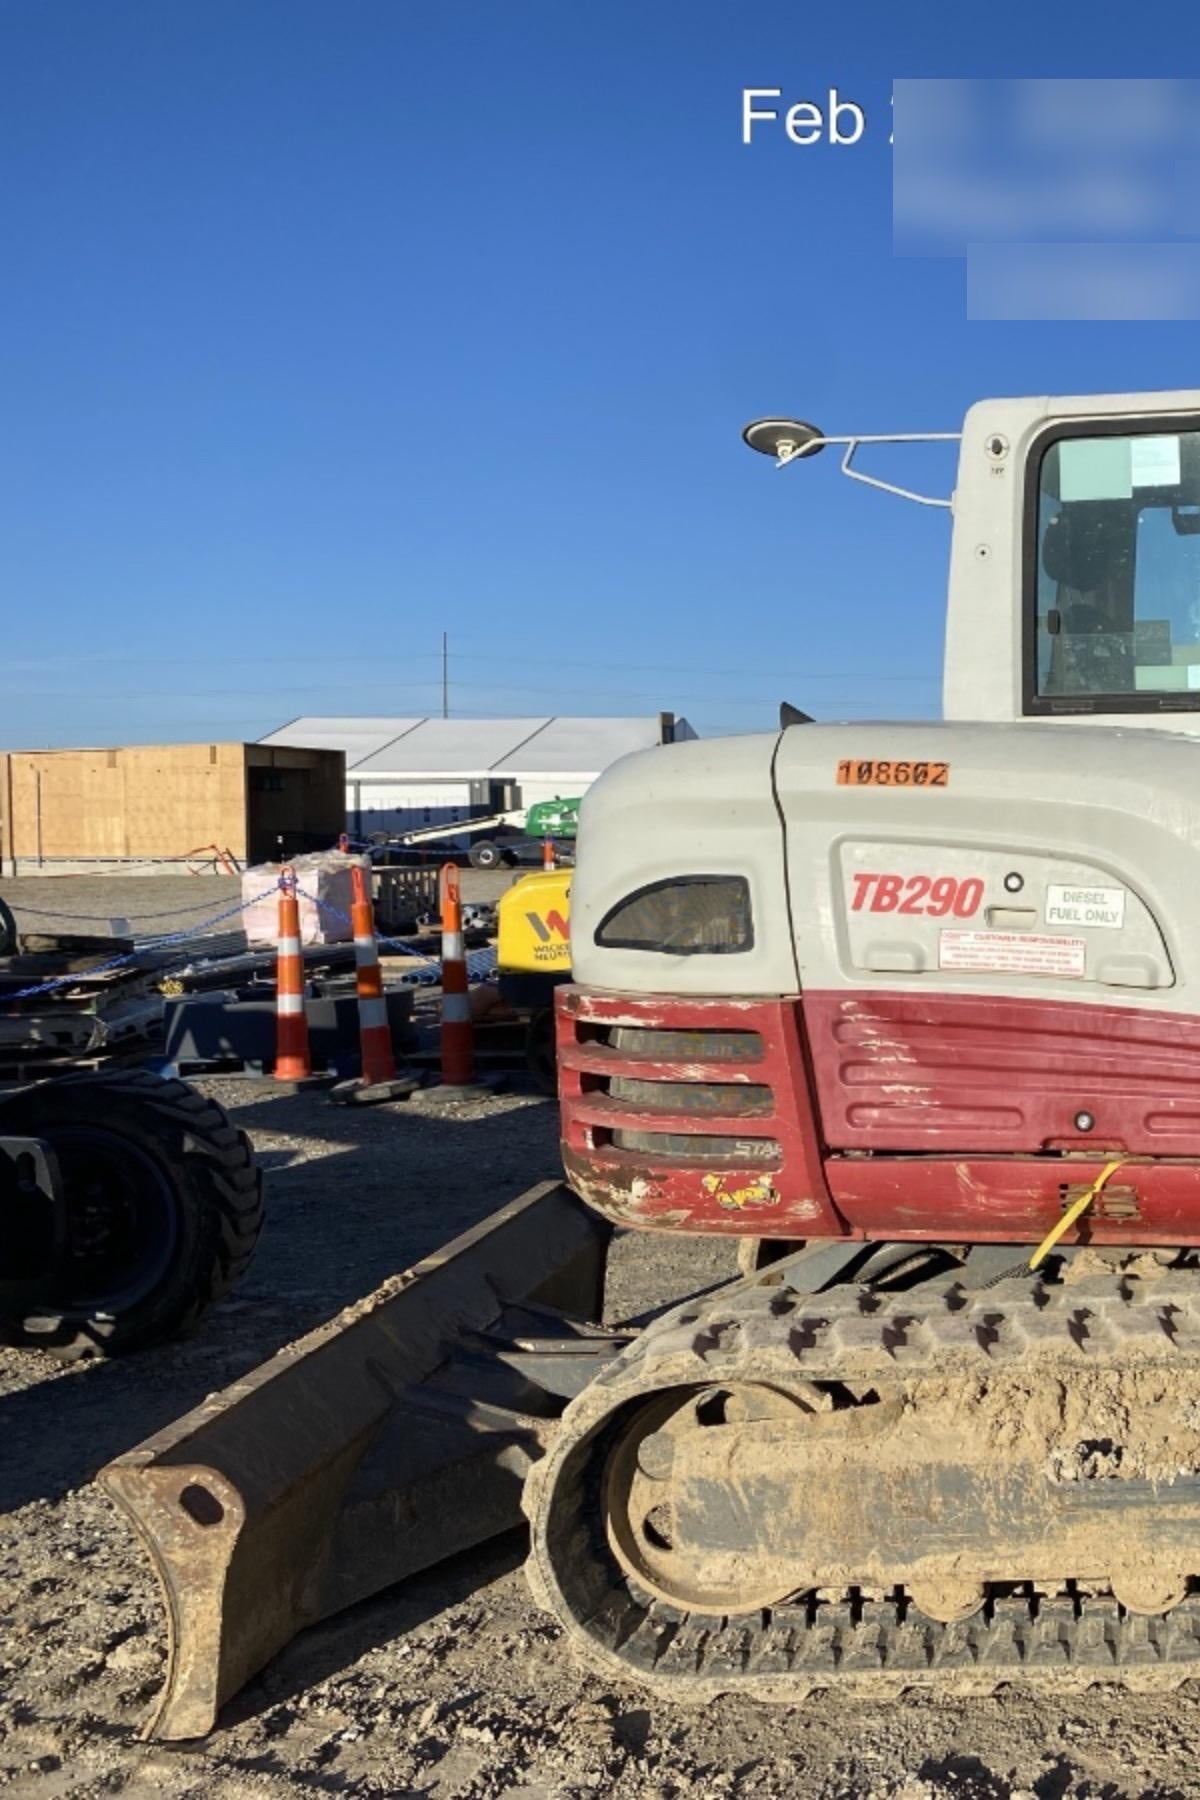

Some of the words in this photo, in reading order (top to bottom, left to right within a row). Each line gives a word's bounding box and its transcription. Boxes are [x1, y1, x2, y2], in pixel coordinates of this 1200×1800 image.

[838, 761, 948, 786] 108602
[850, 873, 985, 918] TB290
[1063, 890, 1108, 905] DIESEL
[1049, 907, 1081, 921] FUEL
[1085, 909, 1119, 923] ONLY
